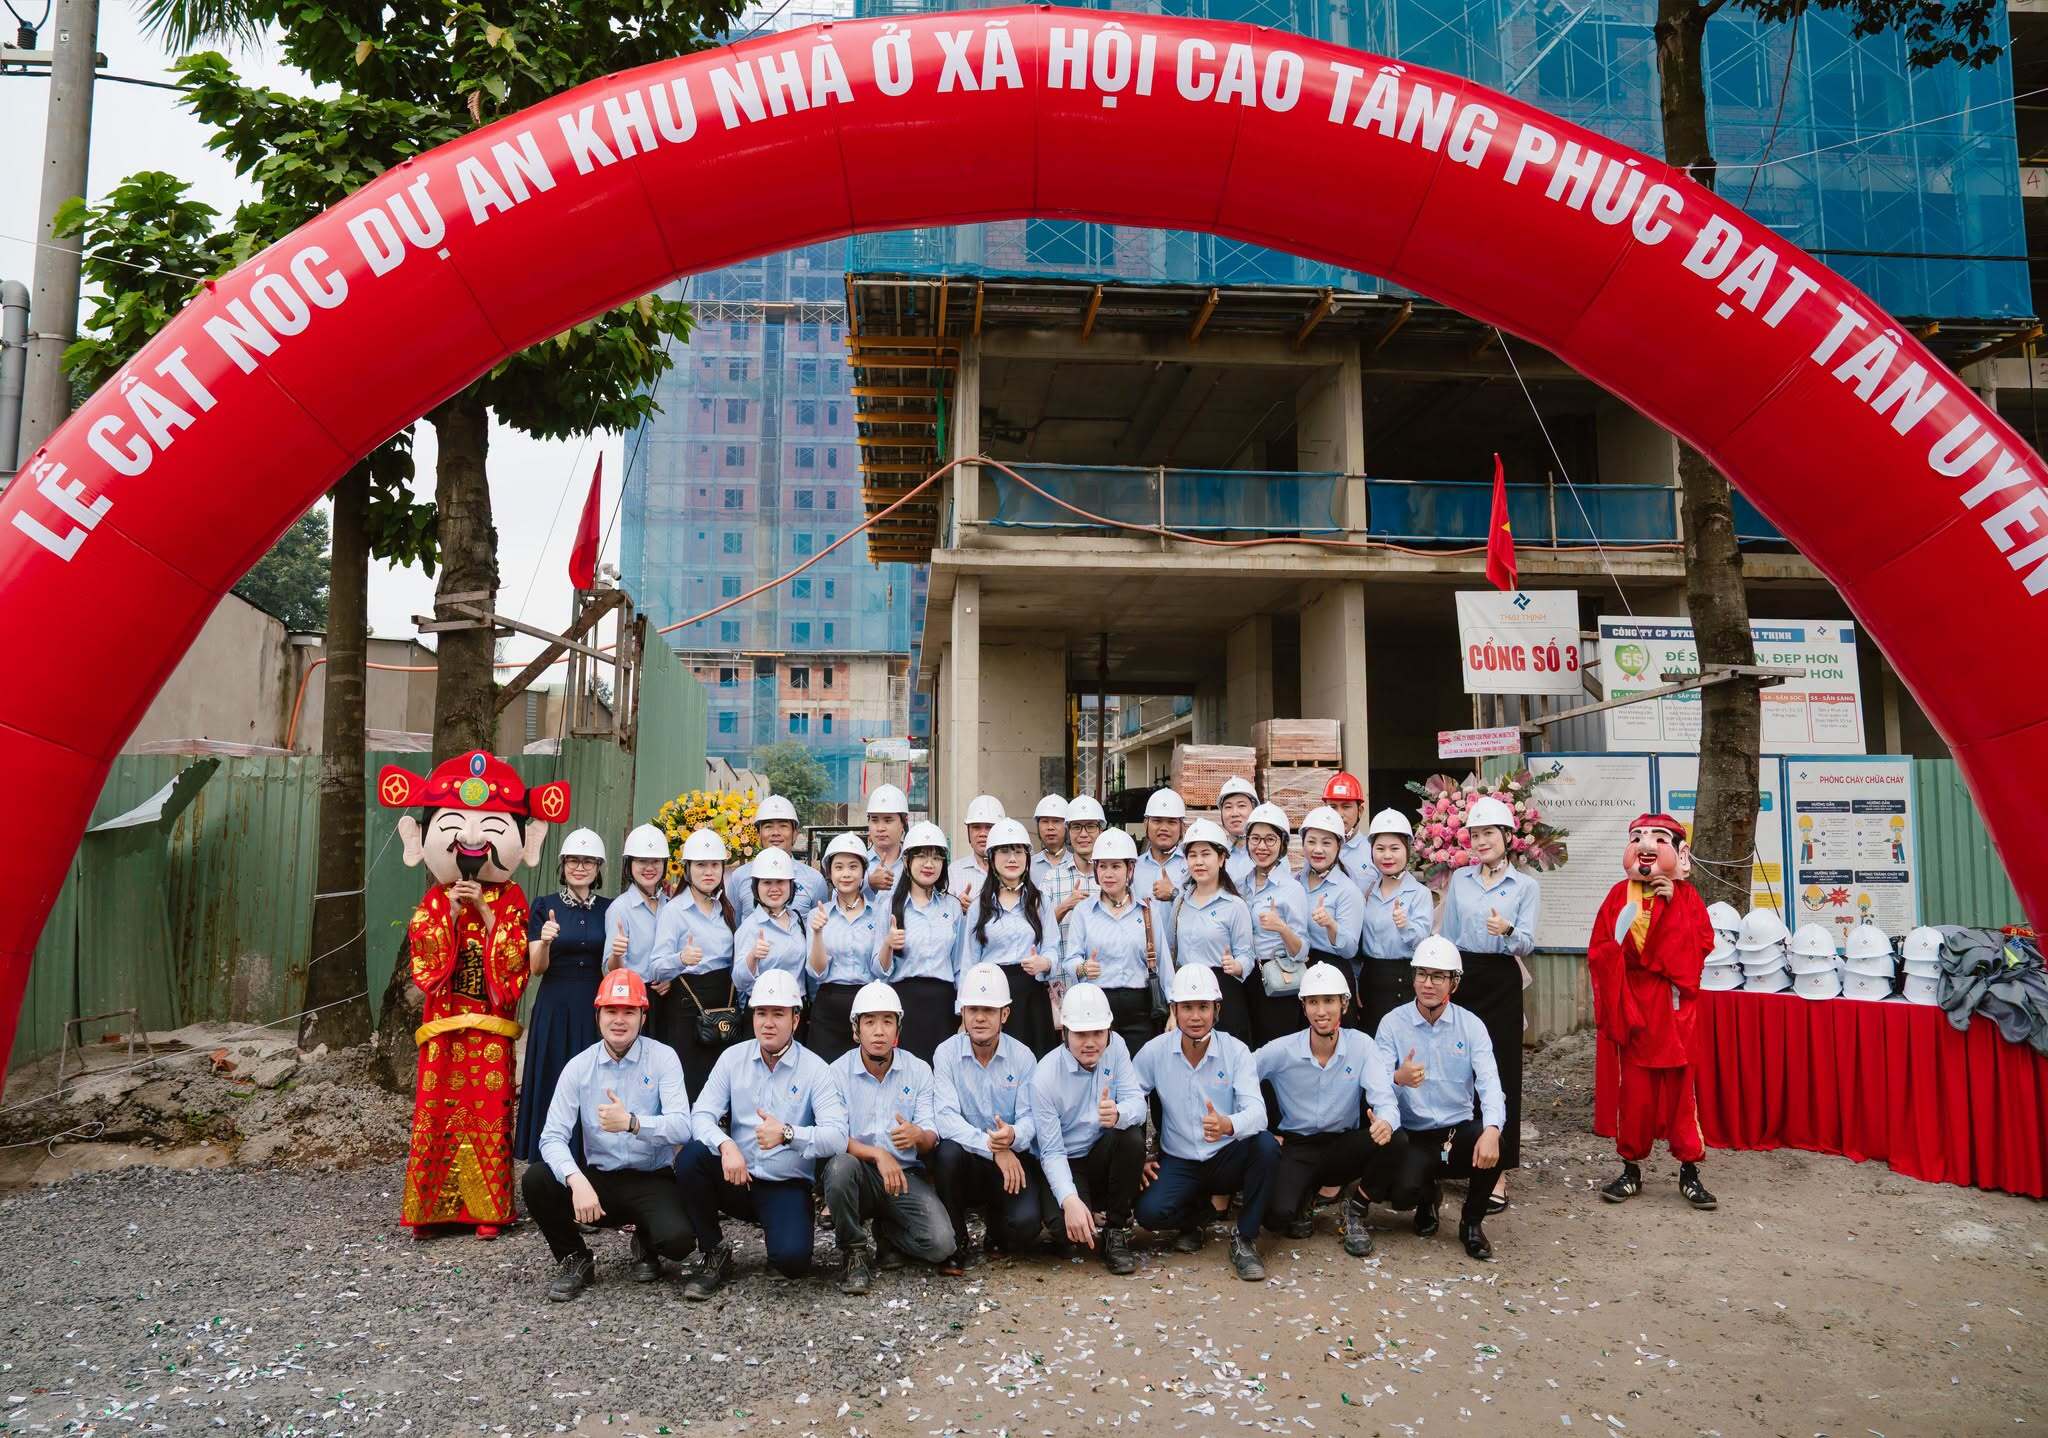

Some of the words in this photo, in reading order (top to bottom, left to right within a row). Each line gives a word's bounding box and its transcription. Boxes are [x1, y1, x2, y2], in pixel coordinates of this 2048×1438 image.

[10, 450, 114, 562] LỄ
[86, 345, 218, 477] CẤT
[202, 245, 349, 374] NÓC
[345, 171, 450, 260] DỰ
[455, 129, 557, 226] AN
[556, 75, 698, 175] KHU
[707, 34, 854, 130] NHÀ
[872, 23, 914, 97] Ở
[934, 20, 1024, 93] XÃ
[1047, 22, 1159, 108] HỘI
[1175, 37, 1308, 113] CAO
[1327, 63, 1500, 170] TẦNG
[1502, 123, 1685, 246] PHÚC
[1681, 213, 1821, 329] ĐẠT
[1811, 302, 1949, 437] TÂN
[1469, 636, 1526, 672] CỔNG
[1532, 636, 1561, 672] SỐ
[1566, 645, 1579, 672] 3
[1805, 653, 1839, 664] HƠN
[1810, 668, 1844, 679] HƠN
